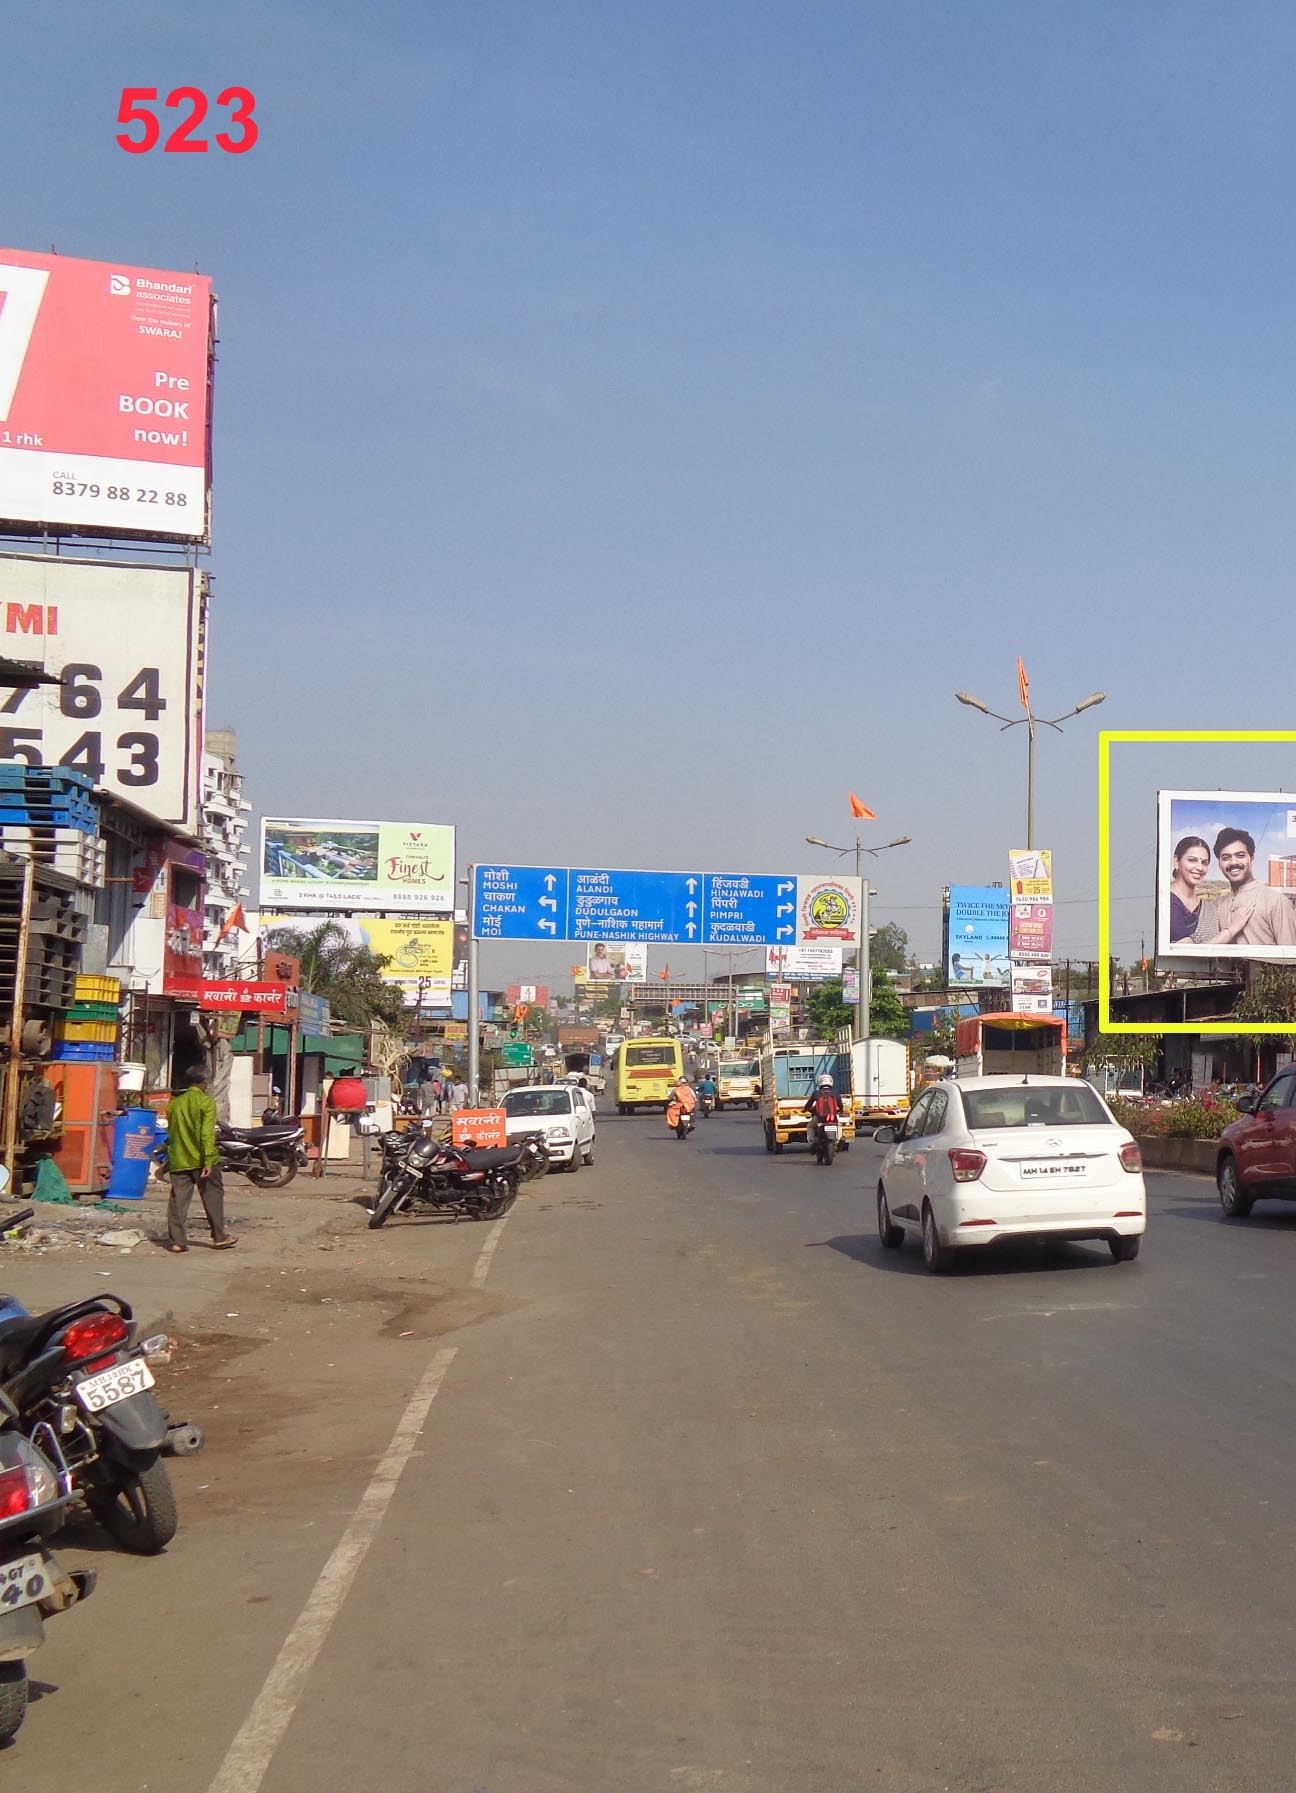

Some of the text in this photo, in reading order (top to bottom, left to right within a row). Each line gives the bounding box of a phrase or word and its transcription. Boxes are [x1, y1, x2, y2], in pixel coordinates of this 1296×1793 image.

[136, 278, 192, 294] Bhandari
[136, 290, 191, 304] associates
[139, 325, 183, 339] SWARAJ
[155, 371, 190, 390] Pre
[119, 395, 190, 419] BOOK
[134, 428, 188, 446] now!
[53, 470, 77, 481] CALL
[52, 481, 187, 507] 8379 88 22 88
[0, 602, 58, 635] MI
[384, 856, 445, 880] Finest
[484, 868, 510, 880] मोशी
[576, 872, 610, 885] आळंदी
[712, 876, 750, 890] हिंजवडी
[482, 881, 518, 890] MOSHI
[576, 886, 613, 894] ALANDI
[483, 892, 515, 902] चाकण
[711, 890, 764, 898] HINJAWADI
[482, 904, 526, 912] CHAKAN
[712, 898, 738, 909] पिंपरी
[575, 908, 638, 916] DUDULGAON
[710, 911, 743, 920] PIMPRI
[482, 914, 502, 928] मोई
[631, 919, 664, 930] महामार्ग
[482, 927, 501, 936] MOI
[710, 922, 755, 935] कुदळवाडी
[574, 931, 679, 942] PUNE-NASHIK HIGHWAY
[710, 934, 766, 942] KUDALWADI
[418, 976, 432, 988] 25
[87, 1368, 146, 1408] 5587
